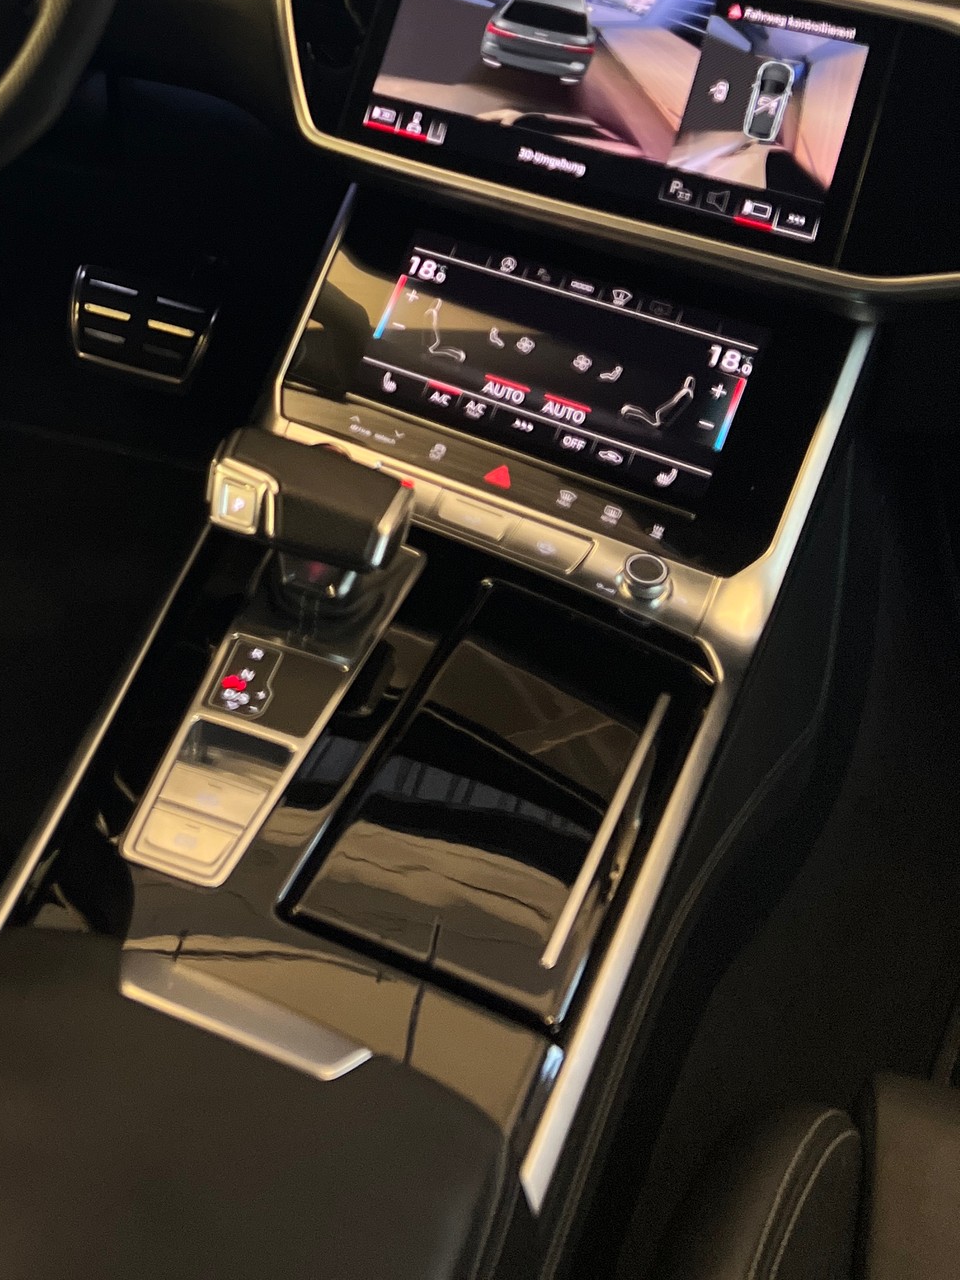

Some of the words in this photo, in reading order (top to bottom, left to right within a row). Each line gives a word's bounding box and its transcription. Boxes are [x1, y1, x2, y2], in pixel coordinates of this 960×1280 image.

[429, 391, 452, 407] A/C
[481, 380, 526, 406] AUTO
[464, 400, 487, 415] A/C
[541, 401, 587, 425] AUTO
[349, 424, 372, 437] drive
[562, 435, 587, 451] OFF
